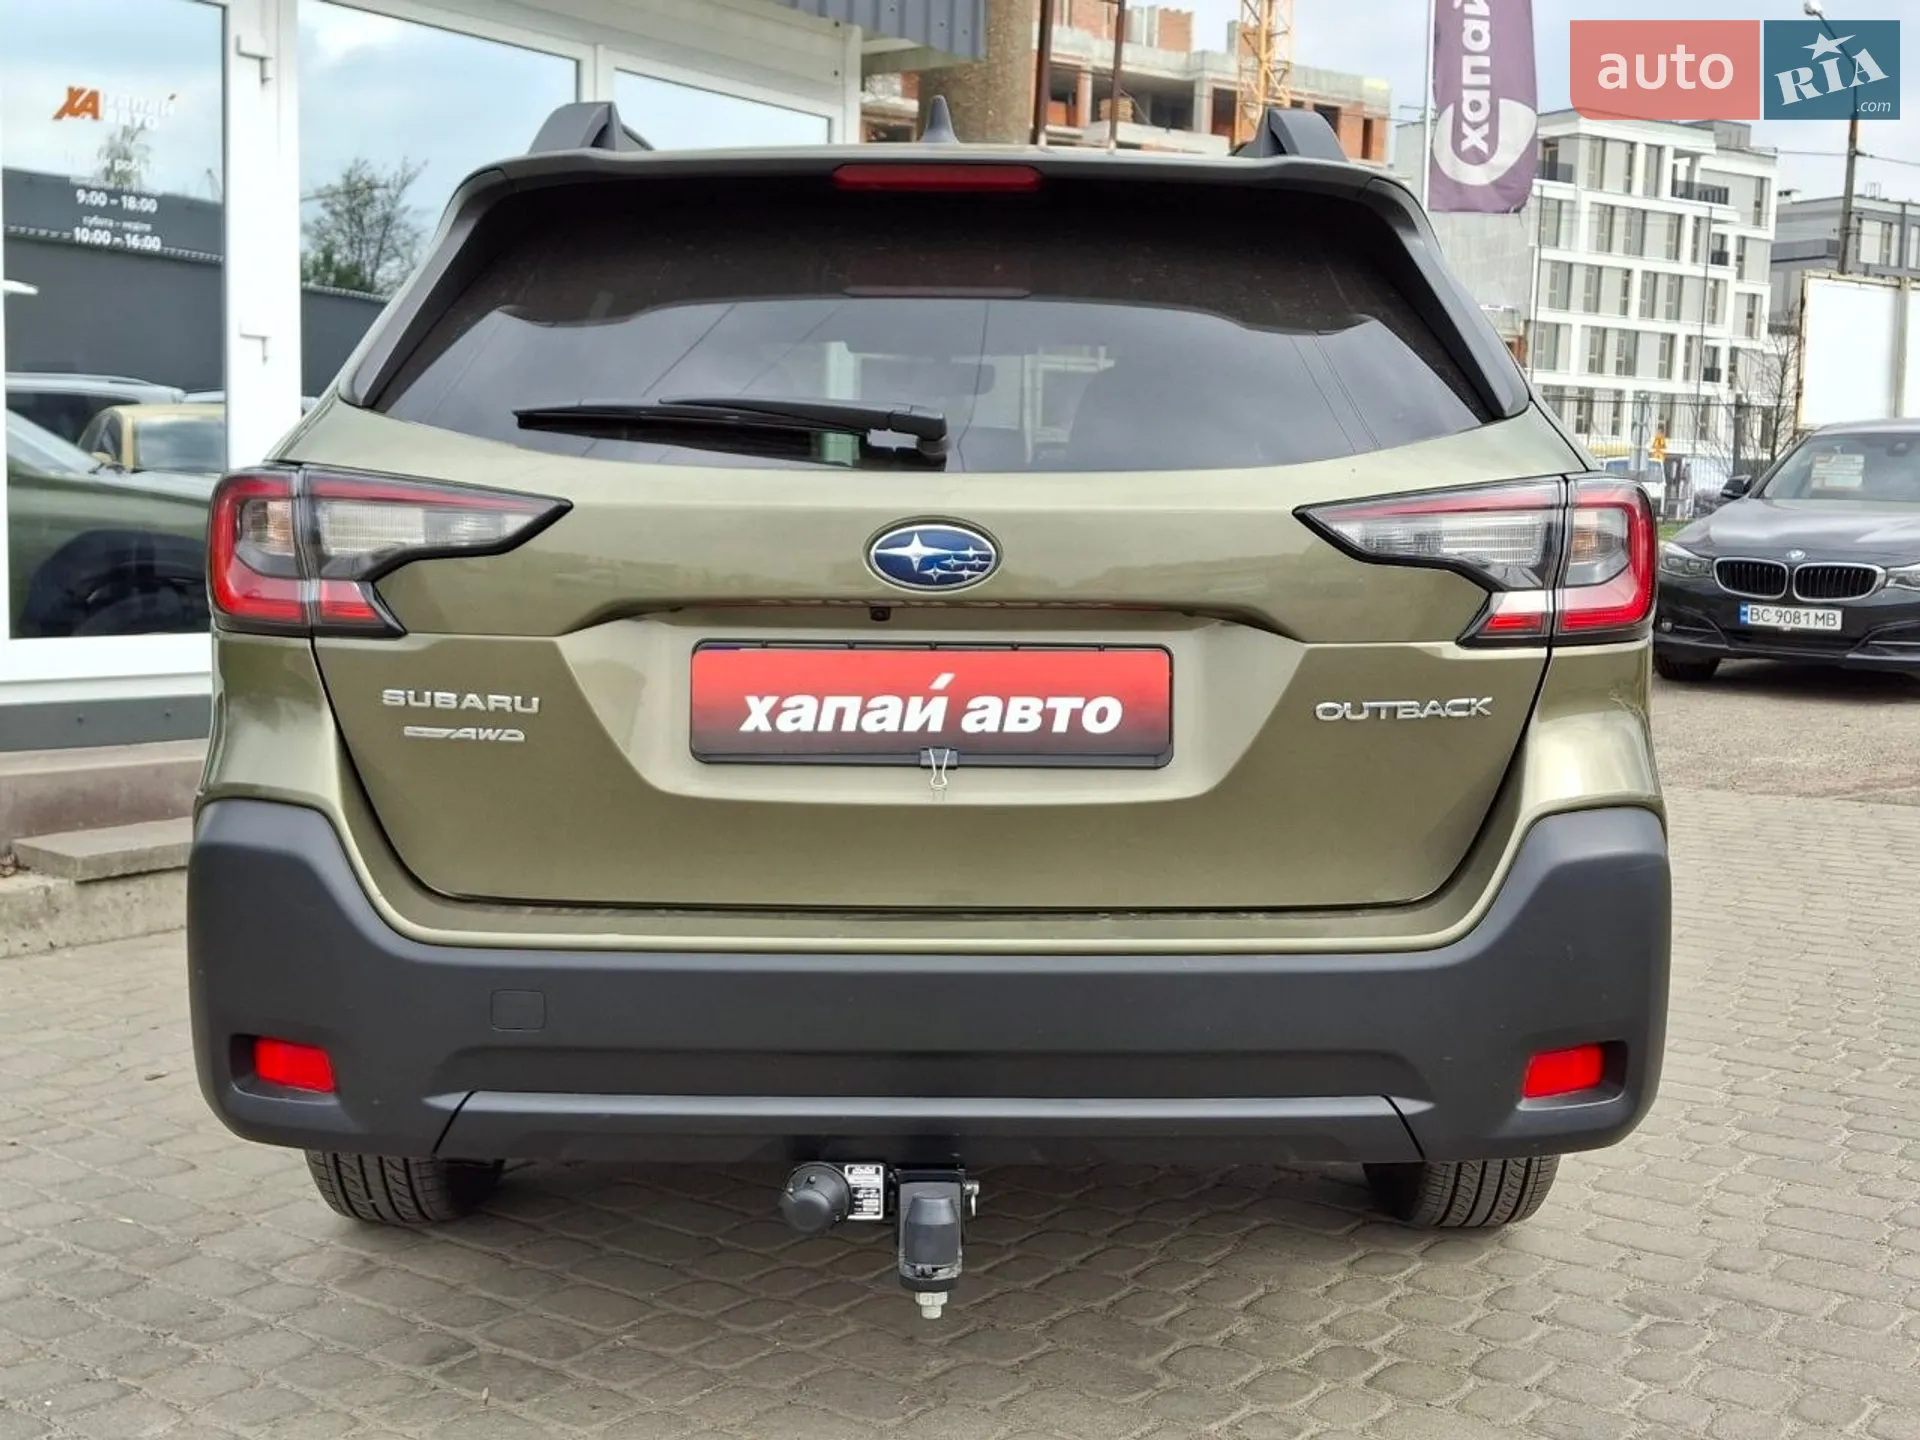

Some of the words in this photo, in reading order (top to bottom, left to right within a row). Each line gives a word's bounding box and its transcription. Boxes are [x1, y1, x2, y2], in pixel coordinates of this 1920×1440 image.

[76, 189, 108, 208] 9:00
[121, 195, 158, 213] 18:00
[74, 227, 112, 245] 10:00
[125, 233, 162, 252] 16:00
[1750, 607, 1773, 623] BC
[1776, 608, 1810, 624] 9081
[1813, 612, 1837, 628] MB
[382, 689, 540, 714] SUBARU
[1315, 696, 1493, 722] OUTBACK
[961, 694, 1123, 735] авто
[450, 727, 526, 742] AWD
